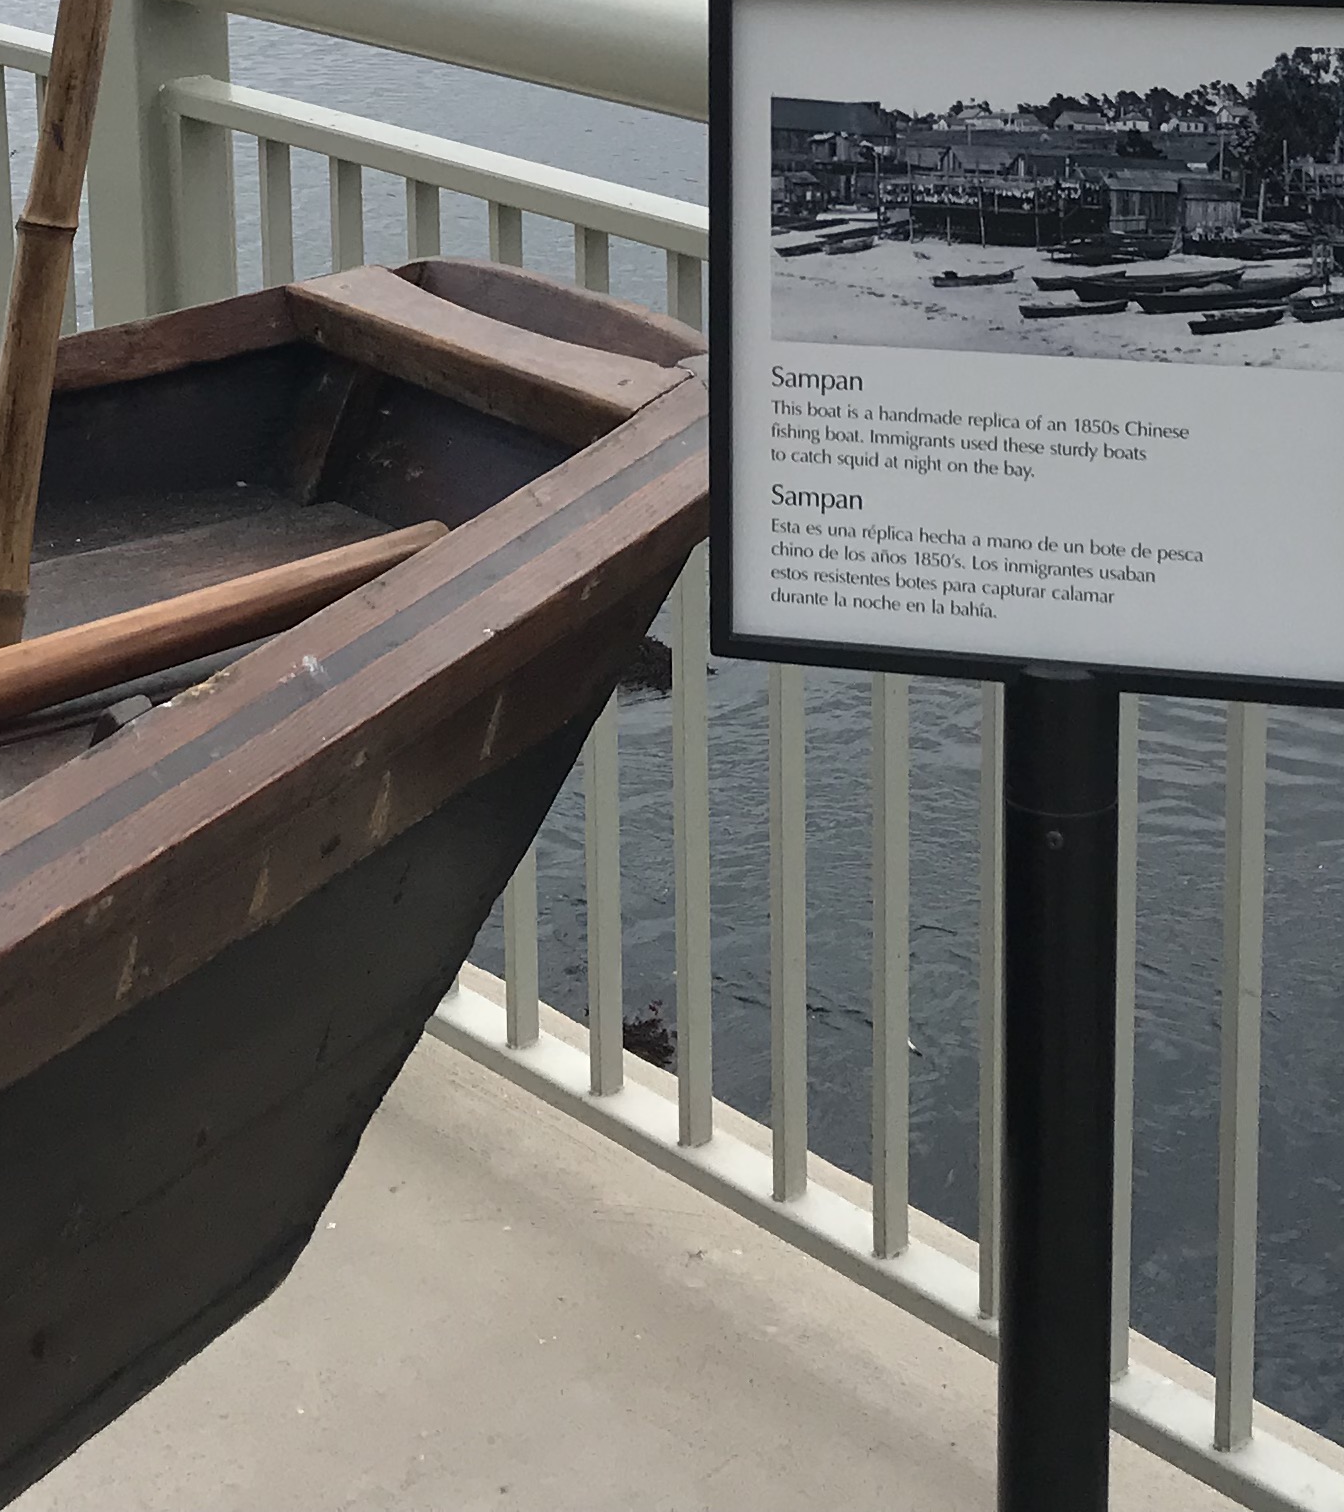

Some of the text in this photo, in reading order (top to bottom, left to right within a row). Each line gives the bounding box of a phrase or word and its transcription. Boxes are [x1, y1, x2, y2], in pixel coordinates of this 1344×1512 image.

[772, 365, 863, 396] Sampan
[771, 398, 1189, 439] This boat is a handmade replica of an 1850s Chinese
[771, 417, 1146, 462] fishing boat. Immigrants used these sturdy boats
[771, 447, 1034, 482] to catch squid at night on the bay.
[771, 483, 863, 514] Sampan
[771, 518, 1203, 564] Esta es una réplica hecha a mano de un bote de pesca
[771, 541, 815, 560] chino
[819, 544, 839, 561] de
[844, 546, 867, 563] los
[871, 548, 907, 565] años
[973, 555, 999, 573] Los
[1004, 557, 1094, 580] inmigrantes
[1099, 565, 1156, 583] usaban
[771, 567, 1115, 604] estos resistentes botes para capturar calamar
[771, 587, 997, 618] durante la noche en la bahía.
